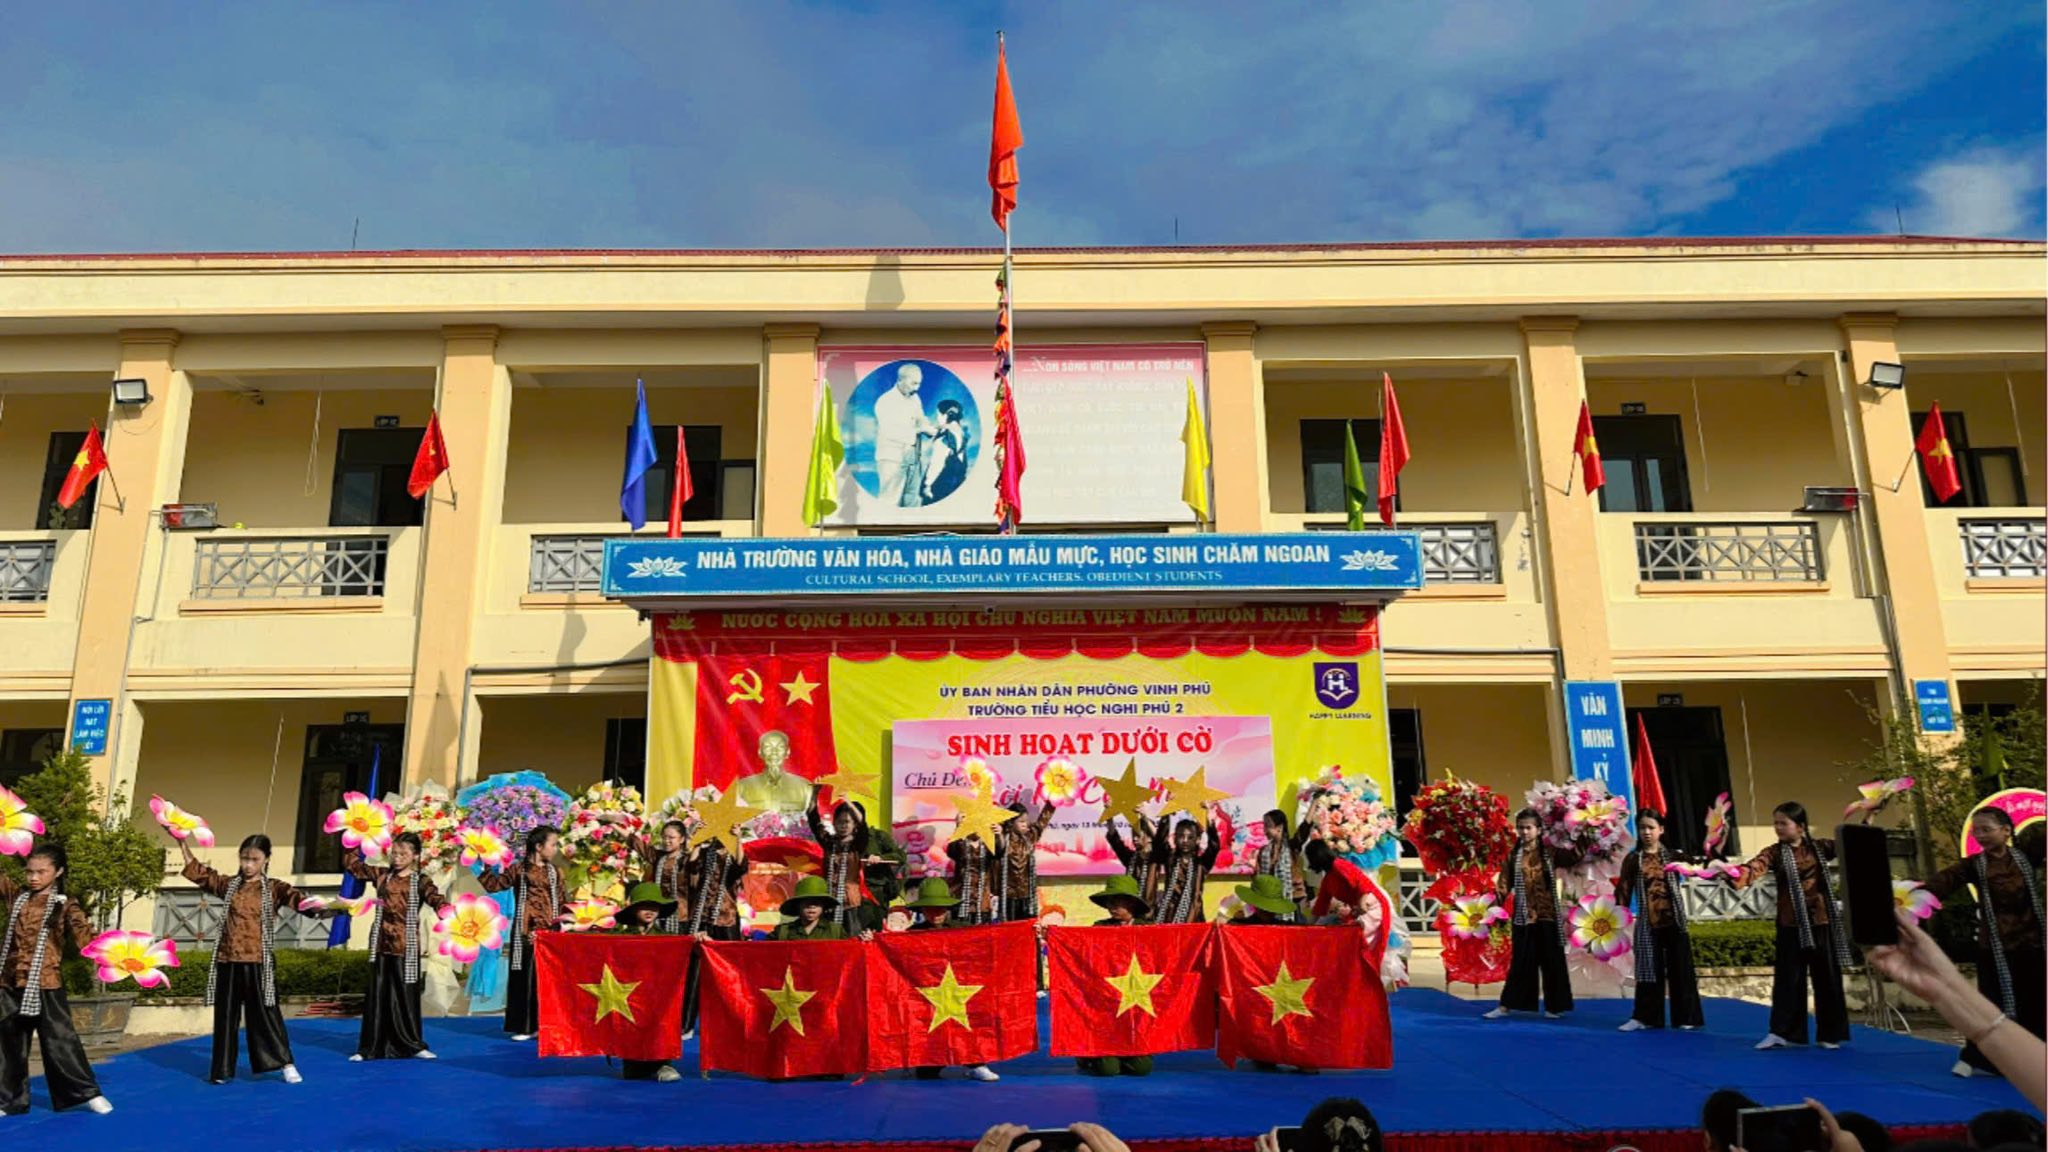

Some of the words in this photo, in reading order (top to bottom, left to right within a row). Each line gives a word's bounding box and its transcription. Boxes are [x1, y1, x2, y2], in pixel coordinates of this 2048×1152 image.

[697, 548, 736, 568] NHÀ
[743, 545, 816, 568] TRƯỜNG
[823, 546, 860, 567] VĂN
[866, 545, 909, 568] HÓA,
[915, 545, 953, 566] NHÀ
[959, 545, 1002, 566] GIÁO
[1008, 541, 1050, 565] MẪU
[1056, 545, 1104, 568] MỰC,
[1110, 546, 1147, 568] HỌC
[1153, 546, 1198, 564] SINH
[1204, 542, 1258, 564] CHĂM
[1264, 545, 1330, 563] NGOAN
[805, 574, 874, 585] CULTURAL
[877, 574, 934, 584] SCHOOL,
[936, 572, 1012, 583] EXEMPLARY
[1087, 571, 1150, 582] OBEDIENT
[1154, 570, 1223, 581] STUDENTS
[1144, 609, 1189, 624] NAM
[962, 687, 991, 697] BAN
[996, 684, 1037, 697] NHÂN
[1042, 683, 1072, 697] DÂN
[1077, 683, 1138, 695] PHƯỜNG
[1143, 685, 1178, 695] VINH
[968, 702, 1027, 716] TRƯỜNG
[1031, 699, 1058, 715] TIỂU
[1063, 704, 1096, 717] HỌC
[1101, 704, 1137, 714] NGHI
[1175, 704, 1183, 713] 2
[1581, 692, 1607, 716] VĂN
[948, 734, 1011, 756] SINH
[1102, 726, 1168, 754] DƯỚI
[1177, 725, 1212, 753] CỜ
[1581, 729, 1615, 748] MINH
[1593, 753, 1609, 781] KỶ
